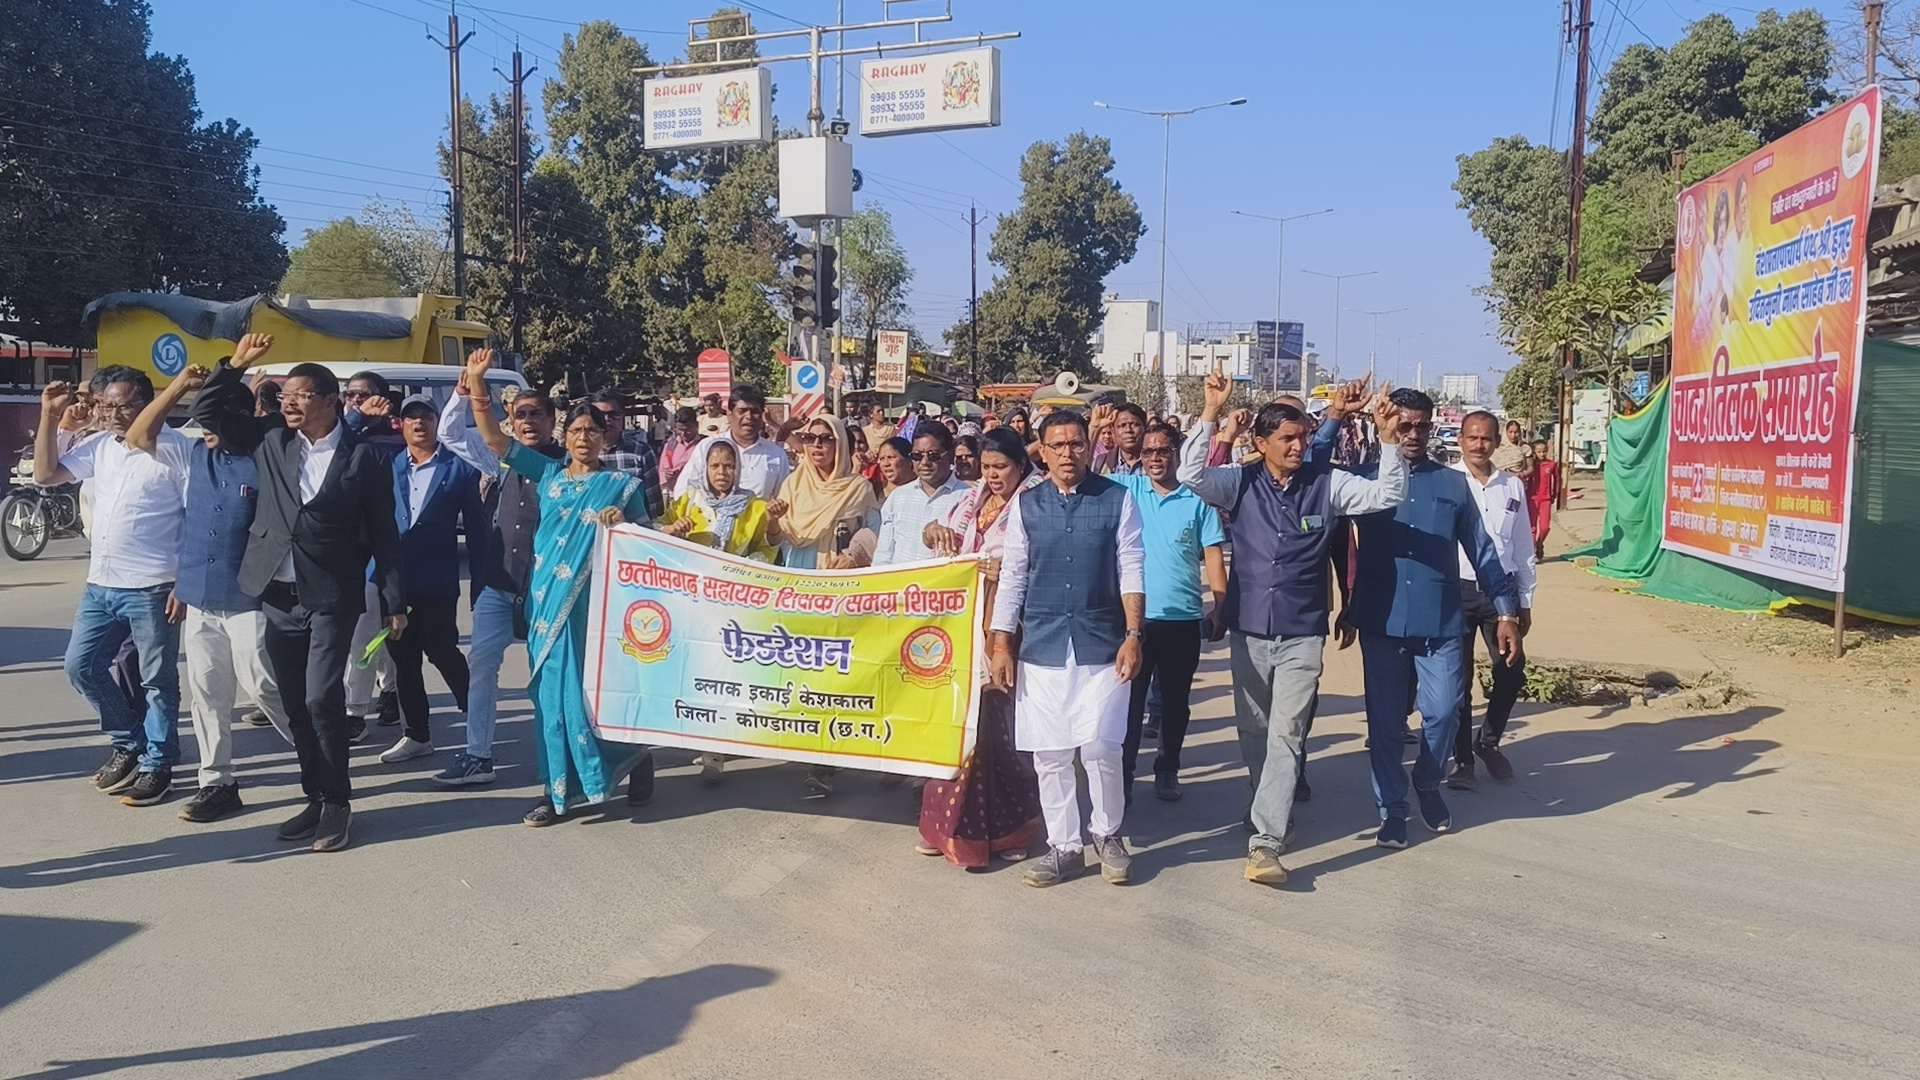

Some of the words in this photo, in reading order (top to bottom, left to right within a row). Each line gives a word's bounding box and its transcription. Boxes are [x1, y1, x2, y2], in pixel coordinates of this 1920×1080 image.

[871, 63, 927, 79] RAGHAV
[654, 83, 703, 97] RAGHAV
[899, 89, 925, 100] 55555
[679, 107, 702, 117] 55555
[899, 101, 925, 111] 55555
[679, 119, 702, 128] 55555
[1818, 217, 1832, 254] श्री
[1801, 271, 1825, 309] साहेब
[1826, 266, 1838, 302] जी
[879, 362, 904, 371] REST
[879, 372, 904, 382] HOUSE
[1709, 347, 1760, 441] तिलक
[1760, 322, 1839, 442] समारोह
[617, 558, 699, 599] छत्तीसगढ़
[703, 576, 773, 606] सहायक
[903, 584, 967, 613] शिक्षक
[721, 619, 852, 671] फेडरेशन
[694, 677, 742, 697] ब्लाक
[749, 681, 793, 705] इकाई
[799, 684, 875, 710] केशकाल
[736, 708, 820, 735] कोण्डागांव
